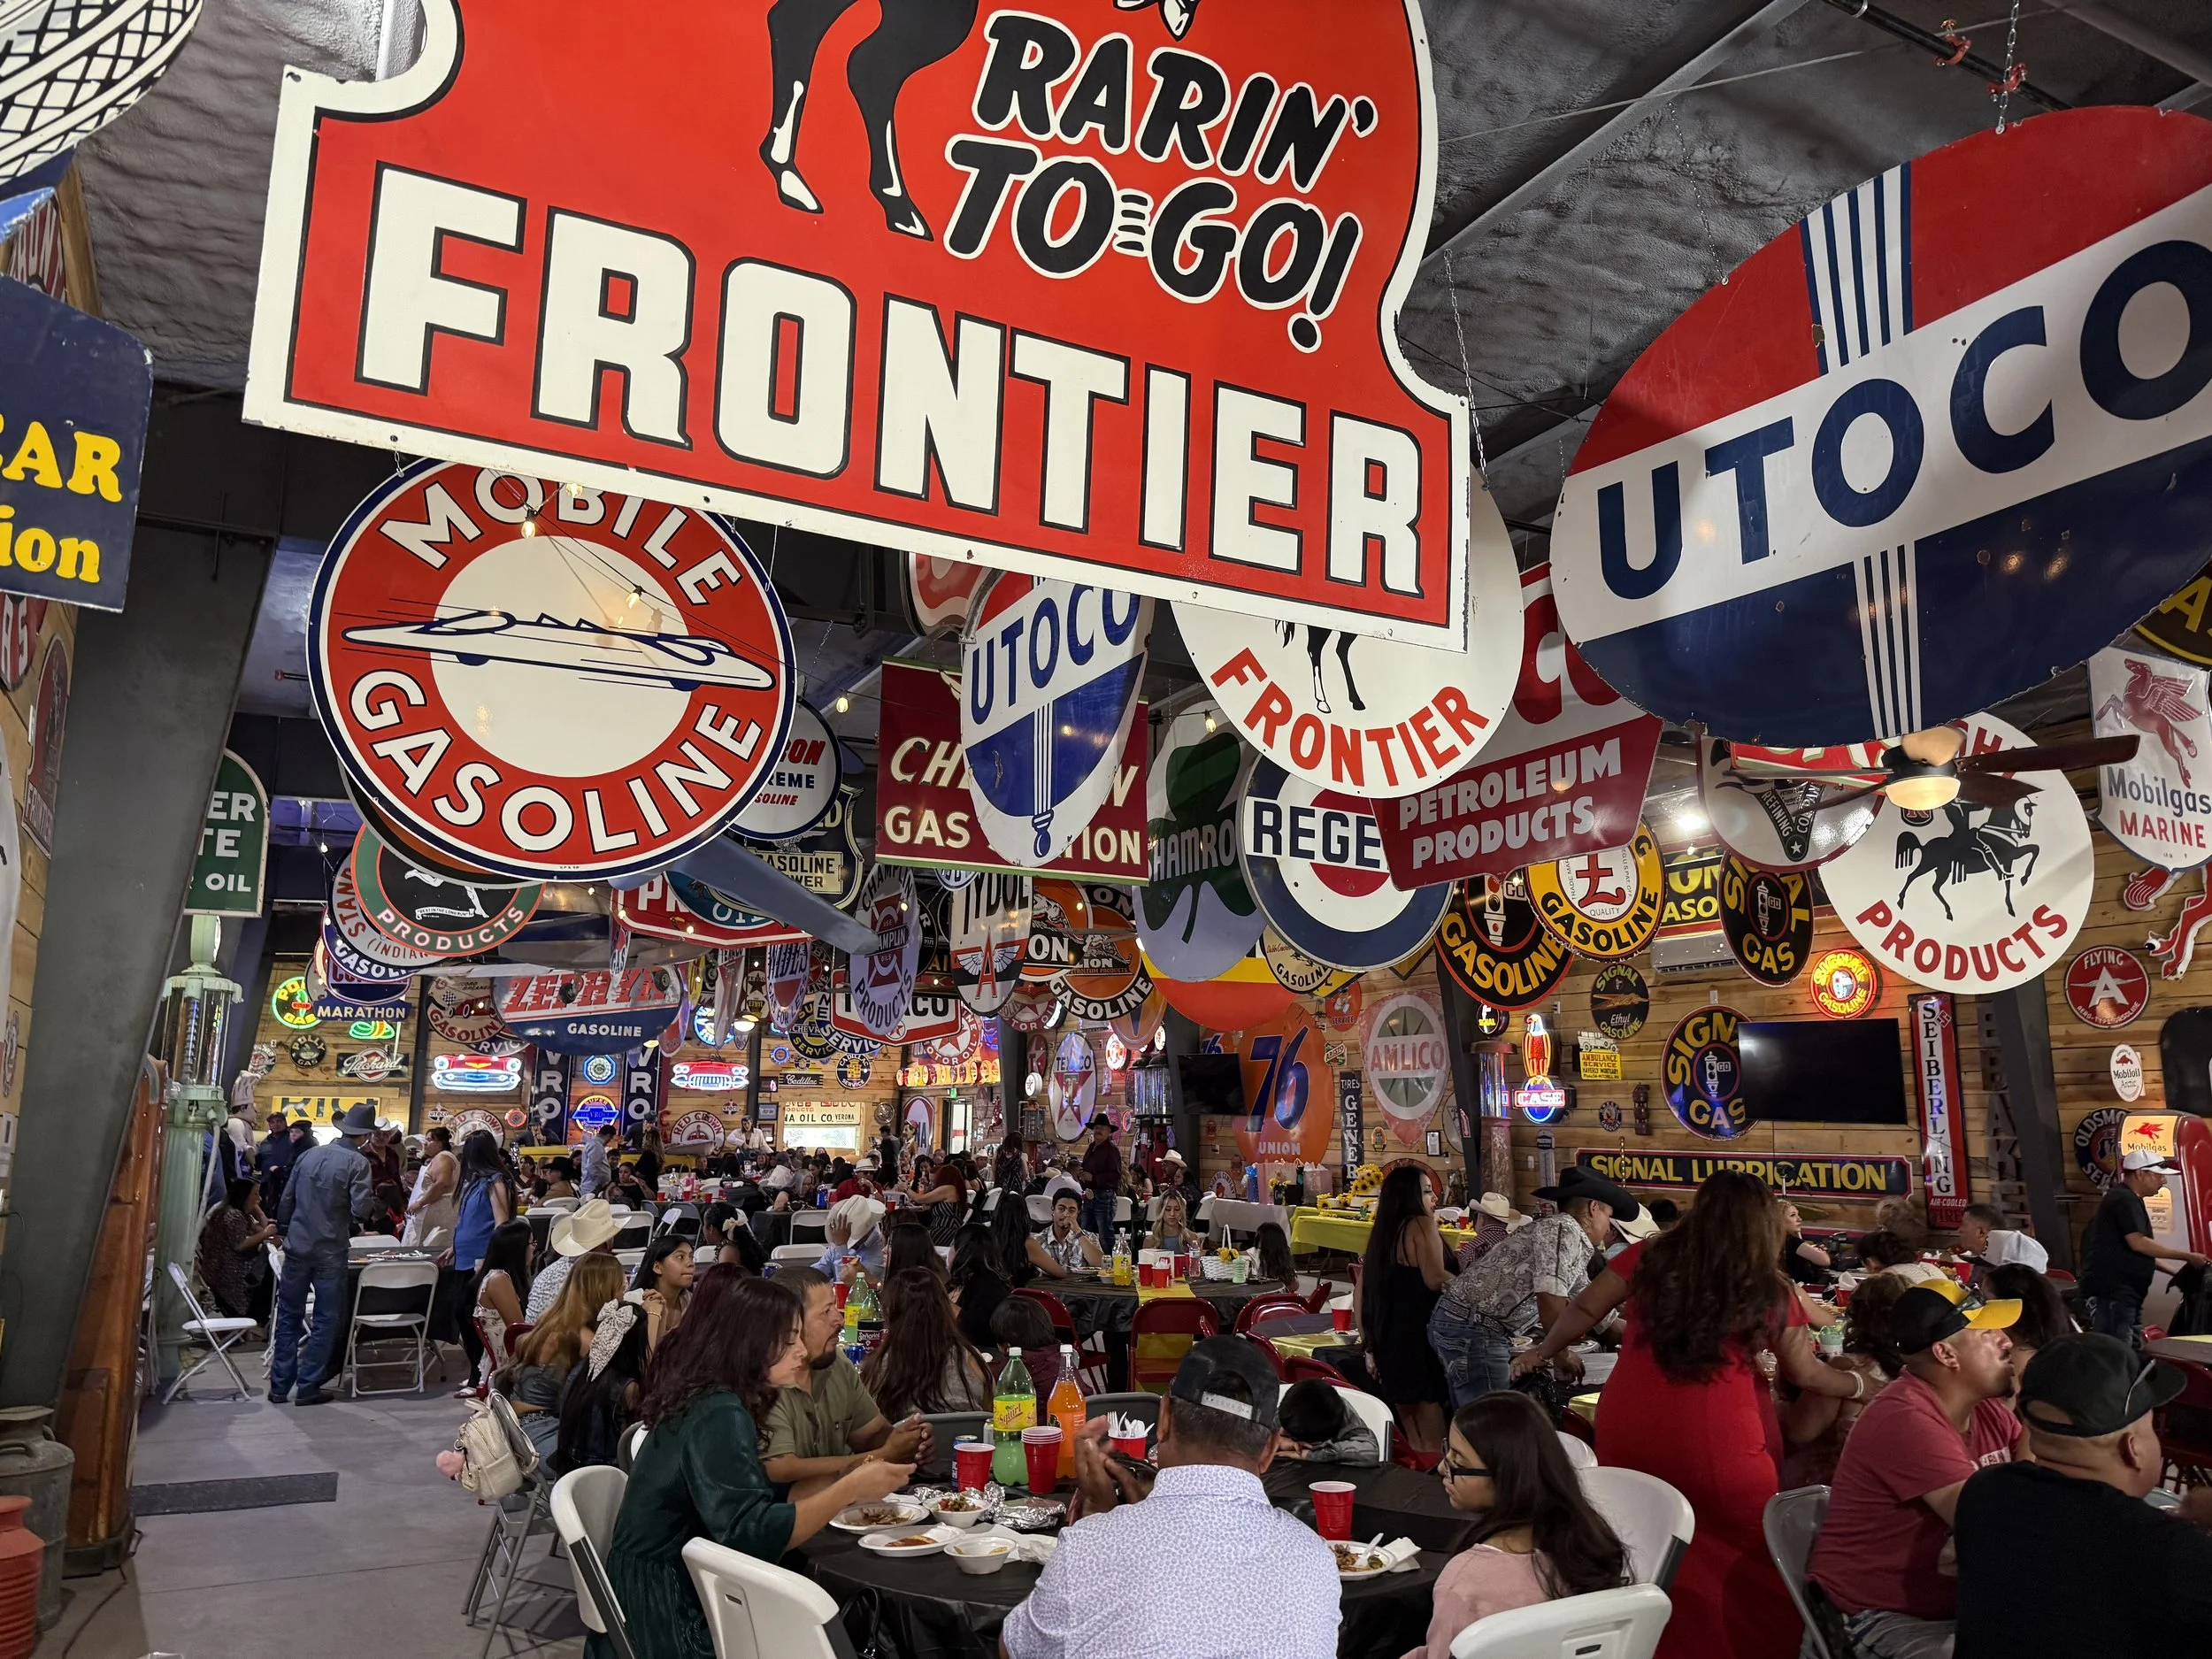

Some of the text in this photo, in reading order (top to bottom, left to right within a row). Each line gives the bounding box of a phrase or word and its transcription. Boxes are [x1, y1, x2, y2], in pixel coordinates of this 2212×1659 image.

[946, 139, 1362, 351] TO GO!
[354, 160, 1424, 597] FRONTIER
[1597, 240, 2212, 599] UTOCO
[0, 420, 122, 503] AR
[378, 466, 743, 606] MOBILE
[1210, 648, 1490, 787] FRONTIER
[350, 669, 764, 855] GASOLINE
[1399, 737, 1622, 831] PETROLEUM
[2107, 764, 2212, 817] Mobilgas
[755, 793, 799, 806] SOLINE
[1762, 791, 1793, 837] REFINING
[885, 806, 971, 849] GAS
[1252, 801, 1385, 870] REGE
[1413, 796, 1594, 869] PRODUCTS
[2119, 810, 2206, 849] MARINE
[757, 856, 835, 874] ASOLINE
[1153, 819, 1236, 882] HAMRO
[205, 872, 251, 893] OIL
[1589, 907, 1620, 917] QUALITY
[1770, 896, 1781, 910] GO
[377, 908, 524, 949] PRODUCTS
[1540, 887, 1658, 952] GASOLINE
[878, 926, 907, 951] AMPLIN
[1742, 932, 1794, 974] GAS
[1855, 899, 2069, 981] PRODUCTS
[335, 943, 407, 978] GASOL
[1441, 912, 1564, 997] GASOLINE
[2084, 950, 2124, 970] FLYING
[1595, 965, 1639, 991] SIGNAL
[1814, 953, 1868, 986] SIGNAL
[317, 1006, 405, 1018] MARATHON
[855, 968, 912, 1028] PRODUCTS
[1050, 978, 1153, 1019] GASOLINE
[1818, 987, 1867, 1014] GASOLINE
[283, 1012, 317, 1025] GAS
[567, 1023, 641, 1037] GASOLINE
[1012, 1020, 1038, 1031] TOR
[1332, 1016, 1354, 1025] SERVICE
[1601, 1017, 1643, 1040] GASOLINE
[293, 1034, 326, 1051] POLLY
[794, 1037, 833, 1056] SERVIC
[821, 1024, 881, 1053] SERVIC
[926, 1041, 977, 1065] OTOR OIL
[1668, 1012, 1738, 1087] SIGN
[342, 1055, 403, 1075] Packard
[840, 1054, 868, 1067] CADILLAC
[1371, 1040, 1445, 1071] AMLICO
[1582, 1054, 1617, 1063] AMBULANCE
[1717, 1063, 1730, 1071] GO
[786, 1074, 818, 1085] Cadillac
[841, 1079, 864, 1088] SERVICE
[1244, 1025, 1310, 1133] 76
[1340, 1079, 1360, 1090] TIRES
[2113, 1069, 2141, 1079] Mobiloil
[1517, 1092, 1563, 1106] CASE
[1923, 1002, 1951, 1194] SEIBERLING
[673, 1117, 691, 1135] RED
[695, 1113, 723, 1134] CROWN
[800, 1114, 817, 1123] OIL
[1689, 1097, 1746, 1129] GAS
[2075, 1107, 2125, 1148] OLDSMO
[1258, 1142, 1301, 1156] UNION
[1344, 1095, 1358, 1179] GENER
[1590, 1155, 1682, 1182] SIGNAL
[1692, 1159, 1887, 1191] LUBRICATION
[1930, 1198, 1967, 1207] AIR-COOLED
